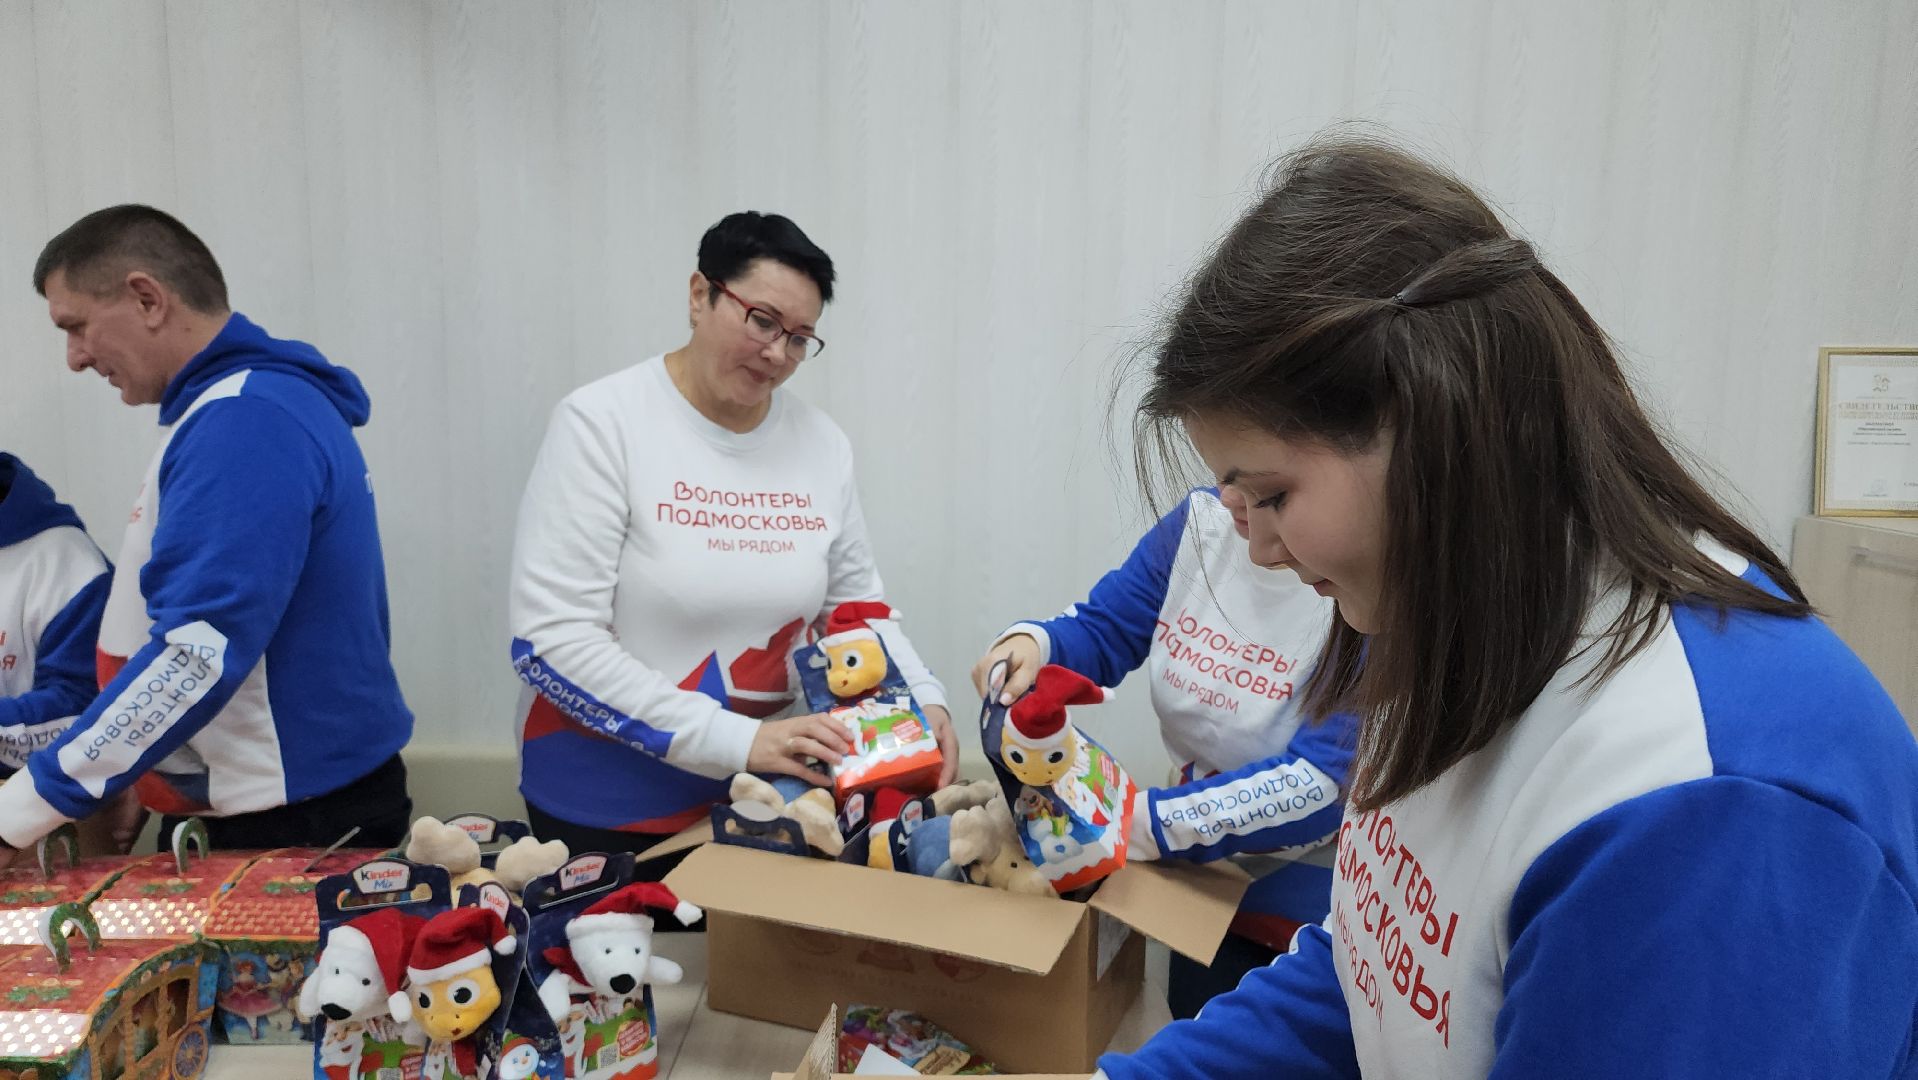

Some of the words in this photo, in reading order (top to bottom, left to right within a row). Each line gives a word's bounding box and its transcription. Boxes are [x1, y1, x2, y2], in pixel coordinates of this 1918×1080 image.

[674, 481, 812, 508] ВОЛОНТЕРЫ
[657, 503, 828, 531] ПОДМОСКОВЬЯ
[708, 538, 734, 552] МЫ
[739, 539, 796, 554] РЯДОМ
[1163, 668, 1187, 690] МЫ
[1158, 767, 1315, 828] ПОДМОСКОВЬЯ
[1193, 785, 1324, 838] ВОЛОНТЕРЫ
